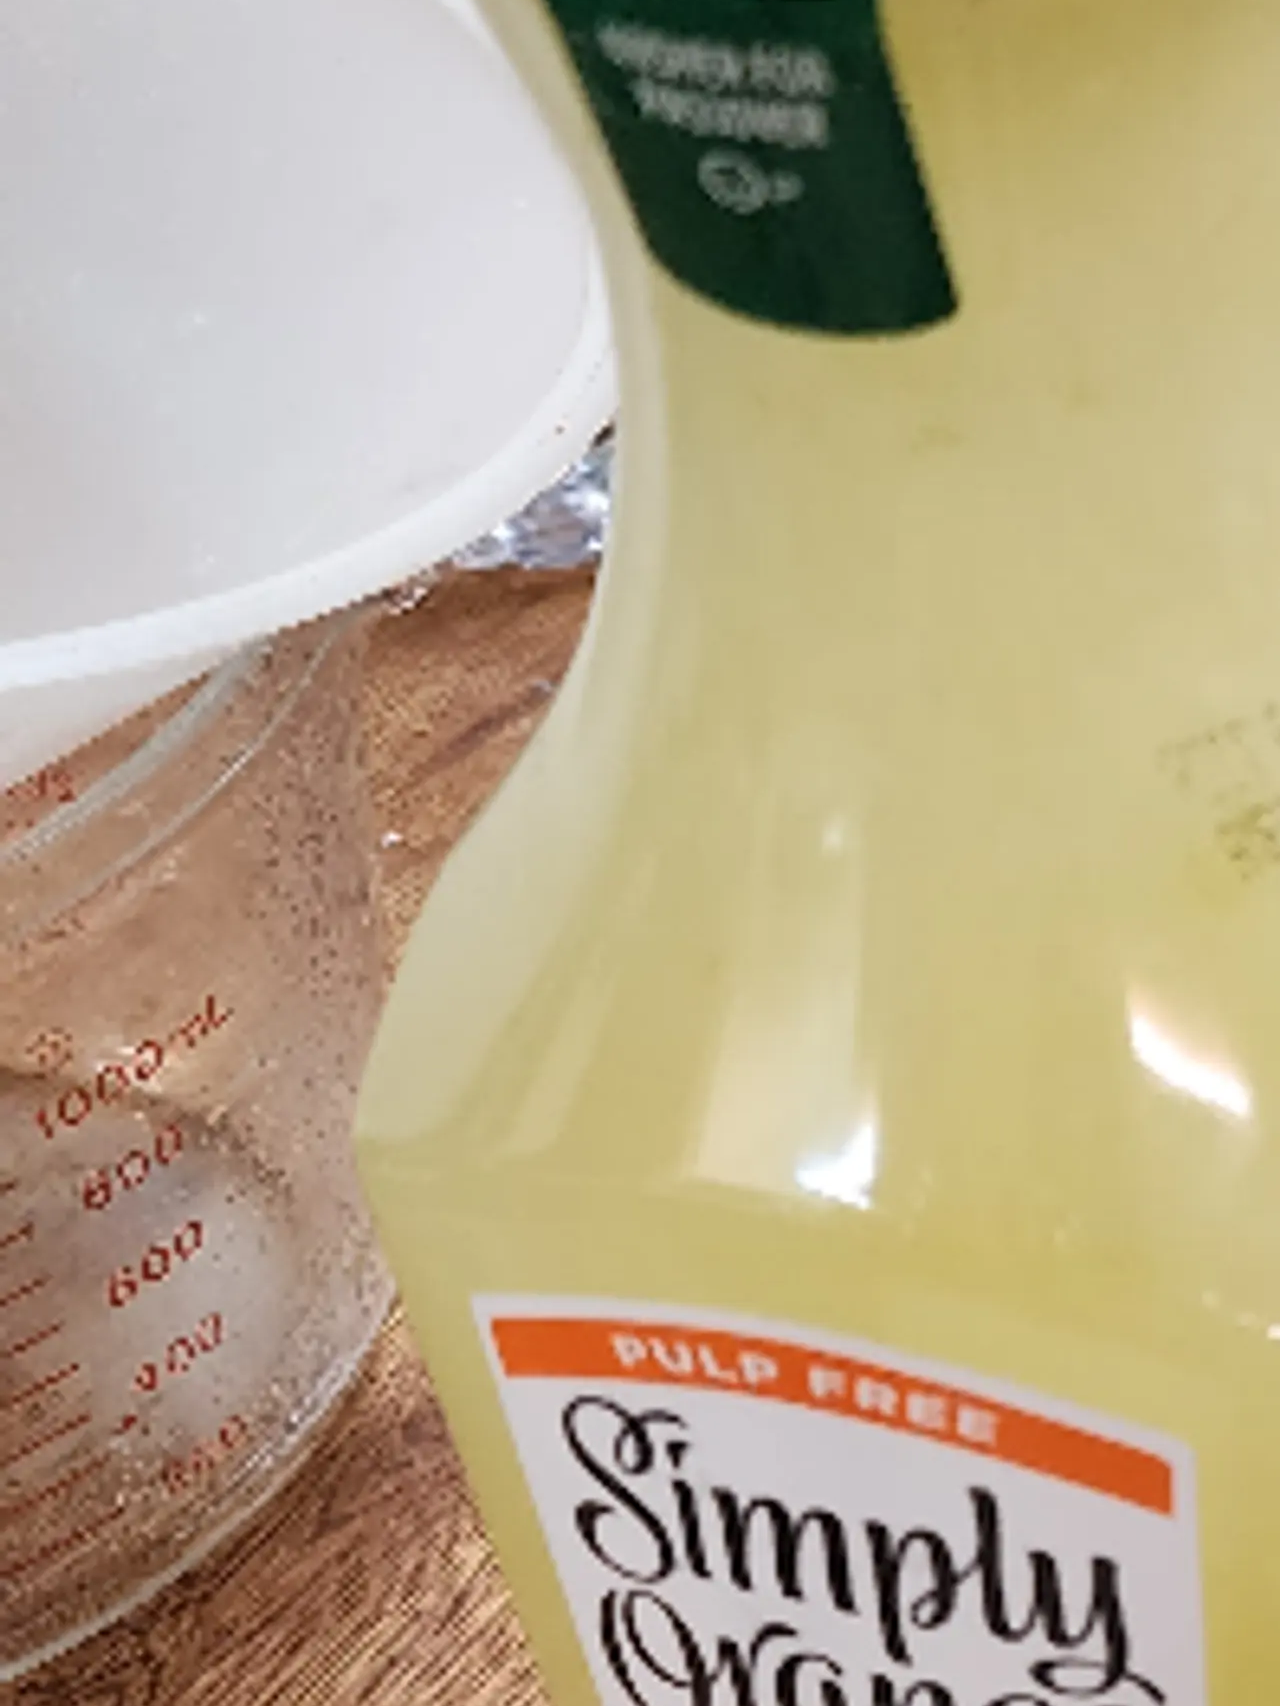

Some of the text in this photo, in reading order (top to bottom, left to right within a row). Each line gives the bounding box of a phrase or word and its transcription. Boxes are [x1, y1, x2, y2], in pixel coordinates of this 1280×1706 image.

[108, 1219, 204, 1308] 600
[610, 1331, 998, 1447] PULP FREE
[561, 1394, 1167, 1706] Simply
